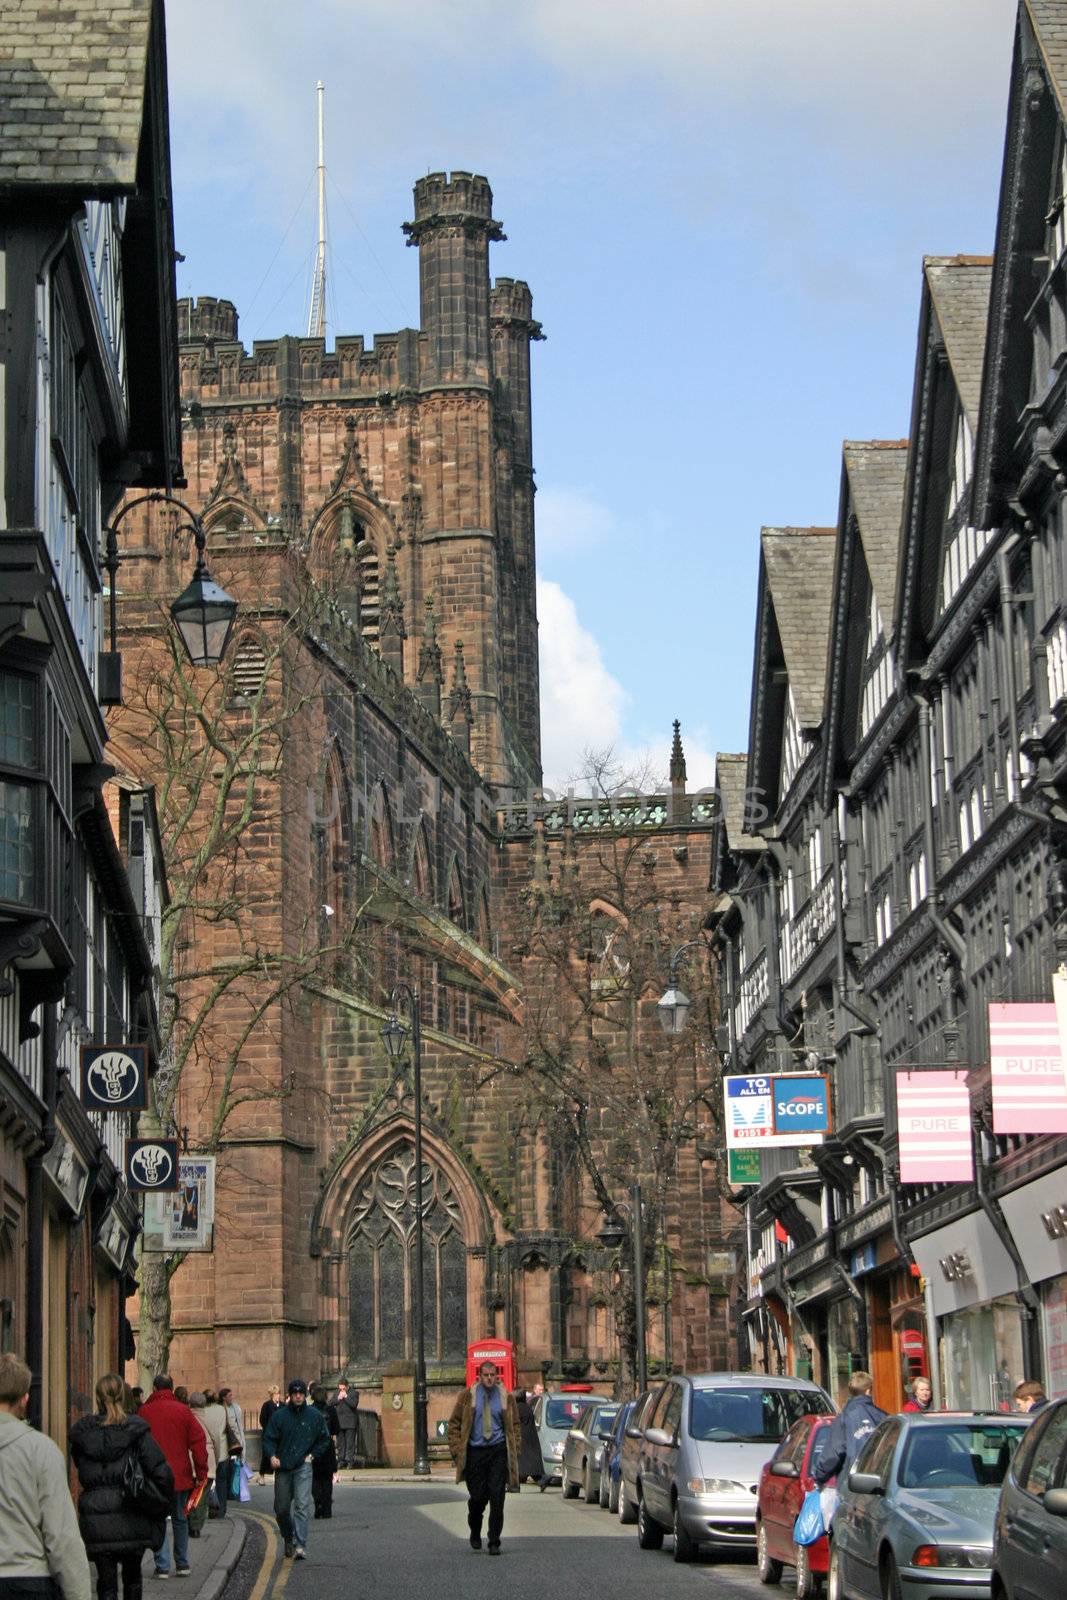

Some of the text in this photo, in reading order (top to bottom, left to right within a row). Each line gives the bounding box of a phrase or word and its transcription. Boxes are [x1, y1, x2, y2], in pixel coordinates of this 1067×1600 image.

[1005, 1057, 1065, 1073] PURE
[746, 1079, 767, 1088] TO
[777, 1102, 824, 1116] SCOPE
[911, 1118, 959, 1131] PURE
[737, 1129, 761, 1137] 0151
